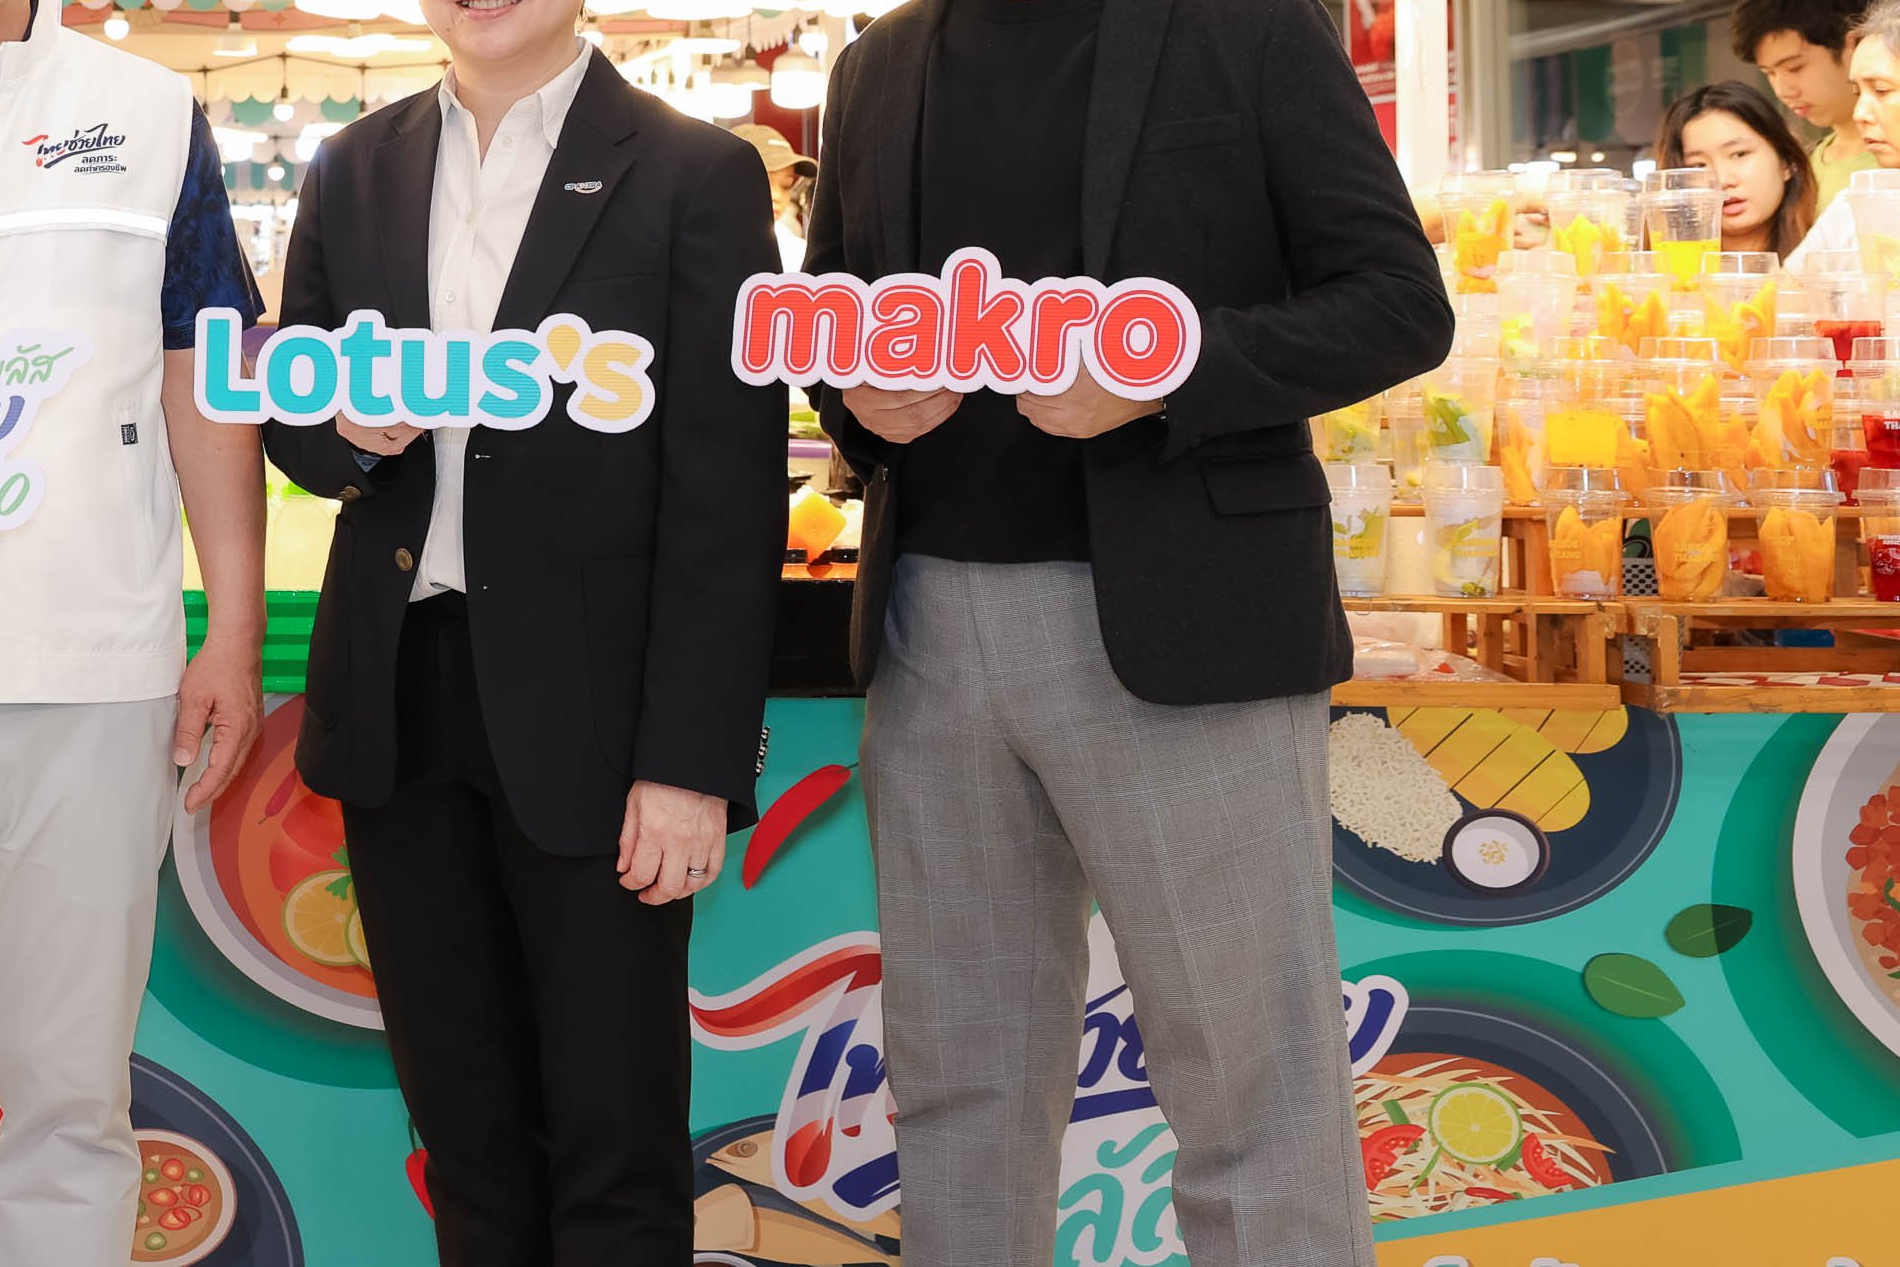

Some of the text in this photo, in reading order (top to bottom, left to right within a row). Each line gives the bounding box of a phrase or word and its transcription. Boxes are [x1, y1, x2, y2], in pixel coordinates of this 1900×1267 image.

[21, 123, 126, 168] ไทยช่วยไทย
[205, 318, 643, 421] Lotus's
[742, 258, 1187, 387] makro
